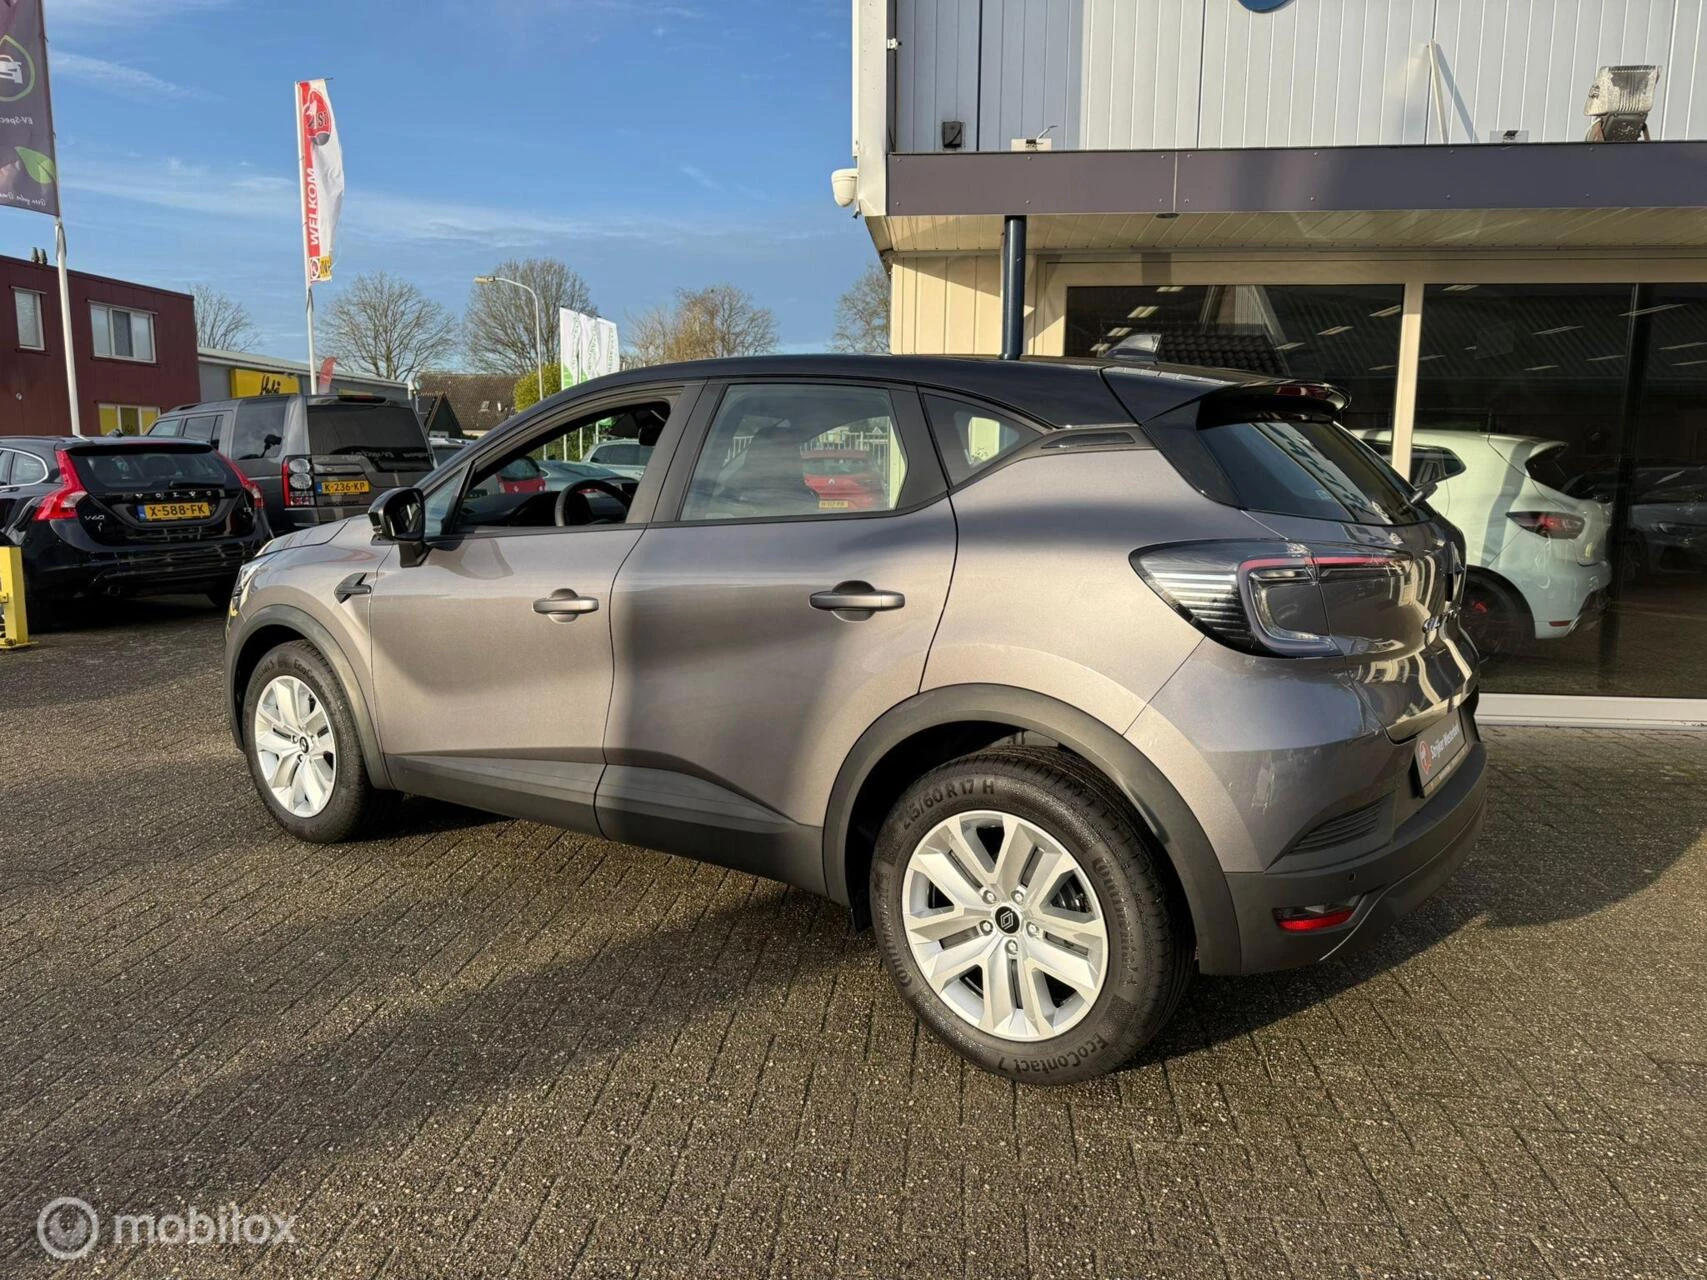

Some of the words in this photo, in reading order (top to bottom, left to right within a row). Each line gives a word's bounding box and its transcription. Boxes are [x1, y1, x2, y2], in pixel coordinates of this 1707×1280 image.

[306, 167, 320, 246] WELKOM
[324, 480, 366, 492] K-236-KP
[149, 503, 207, 518] X-588-FK
[946, 782, 958, 799] R
[960, 778, 975, 795] 17
[982, 778, 995, 794] H
[1012, 1031, 1110, 1075] EcoContact
[997, 1056, 1009, 1072] 7
